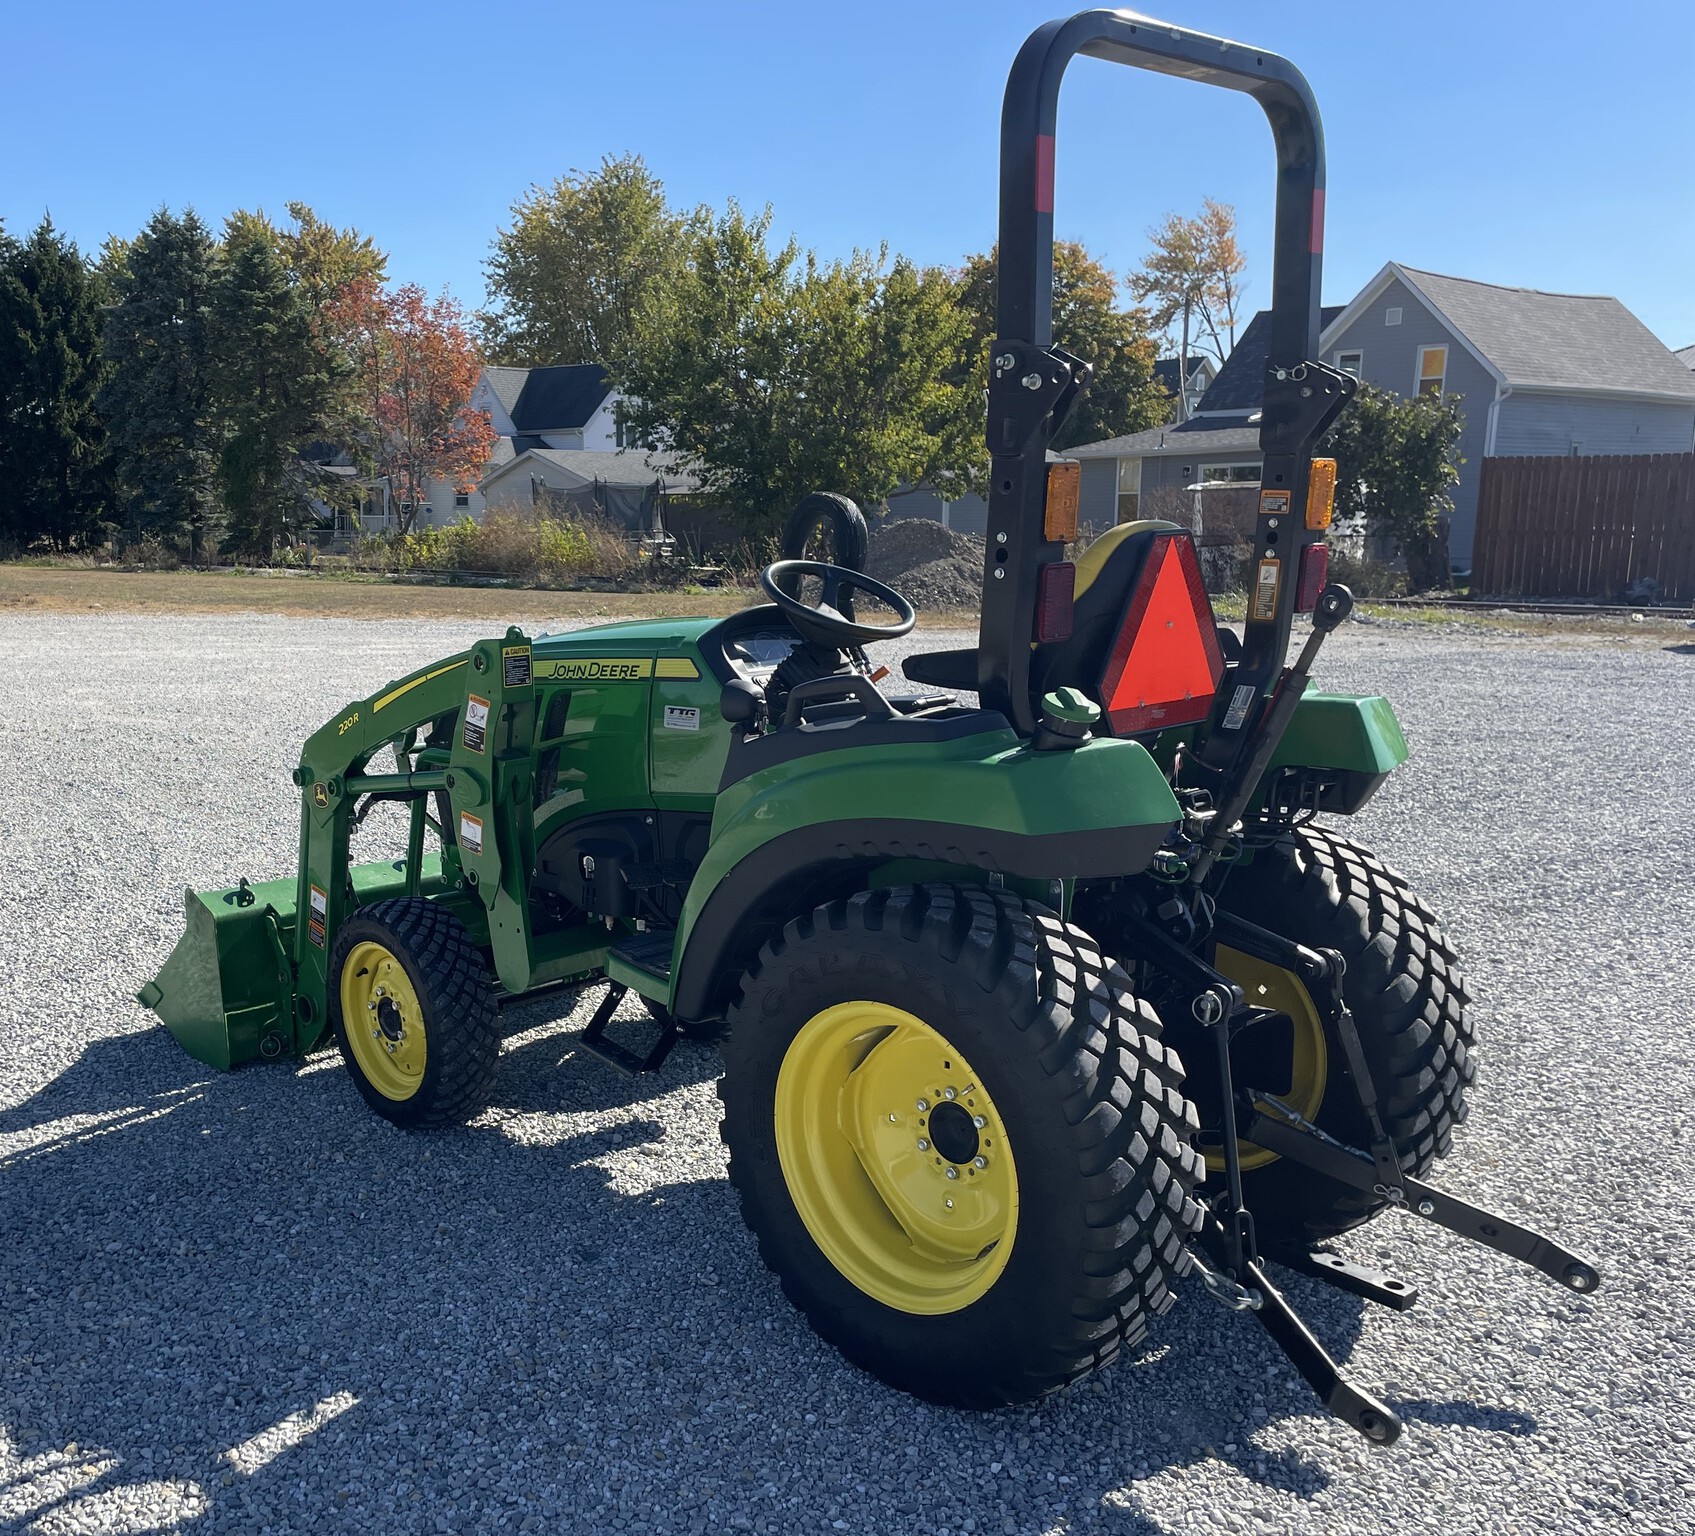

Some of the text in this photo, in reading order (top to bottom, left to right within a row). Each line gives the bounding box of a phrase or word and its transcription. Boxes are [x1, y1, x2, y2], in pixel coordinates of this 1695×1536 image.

[510, 647, 530, 655] CAUTION
[548, 662, 640, 678] JOHN DEERE
[667, 707, 697, 717] TTG
